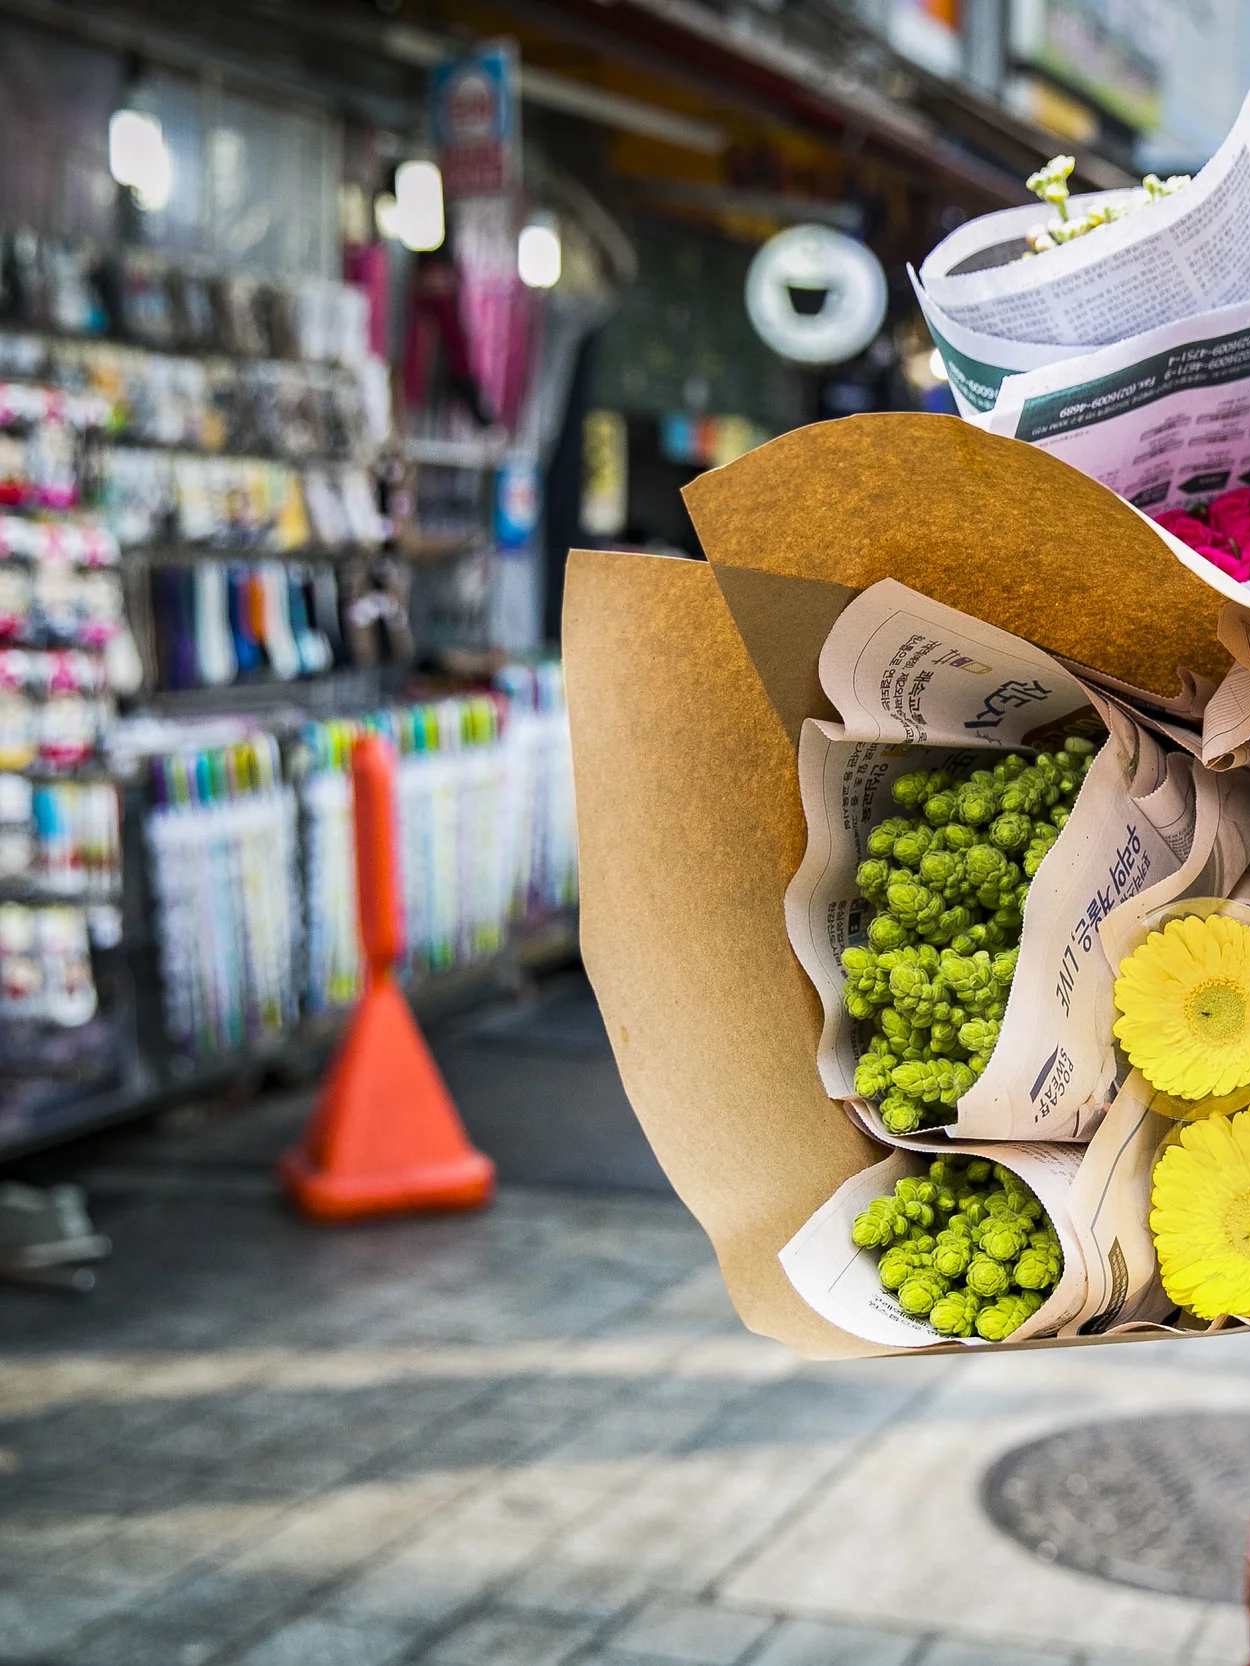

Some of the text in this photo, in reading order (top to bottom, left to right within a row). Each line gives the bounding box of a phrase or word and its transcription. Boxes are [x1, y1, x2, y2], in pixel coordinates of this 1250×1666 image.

[908, 670, 935, 726] 쾌속교통
[861, 763, 889, 823] 안심교육
[1108, 824, 1140, 896] 우리의
[1056, 945, 1079, 1018] LIVE
[1034, 1056, 1075, 1124] POCARI
[1039, 1047, 1067, 1115] SWEAT
